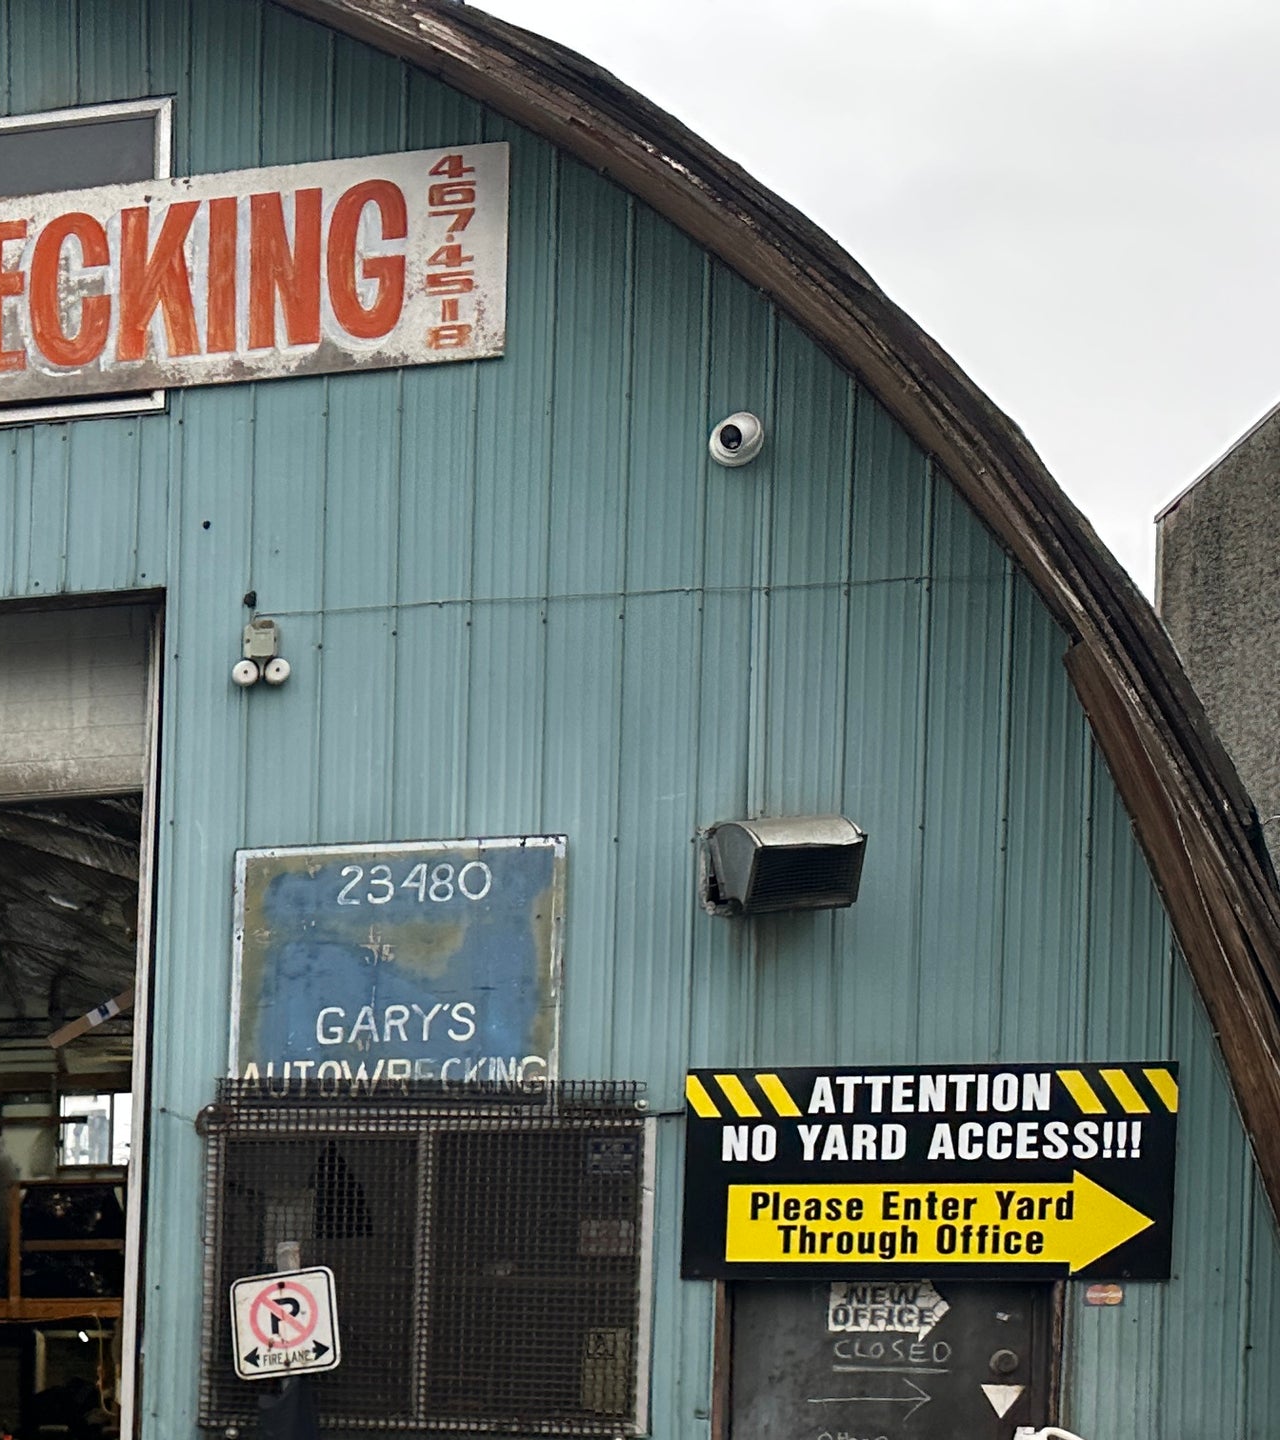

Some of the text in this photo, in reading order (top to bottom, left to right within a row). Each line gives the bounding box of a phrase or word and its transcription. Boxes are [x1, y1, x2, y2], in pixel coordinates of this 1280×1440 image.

[336, 860, 493, 906] 23480
[315, 1001, 477, 1046] GARY'S
[807, 1072, 1051, 1115] ATTENTION
[721, 1120, 1143, 1162] NO YARD ACCESS!!!
[750, 1189, 1075, 1222] Please Enter Yard
[777, 1224, 1045, 1260] Through Office
[847, 1284, 918, 1305] NEW
[831, 1304, 935, 1328] OFFICE
[262, 1352, 284, 1367] FIRE
